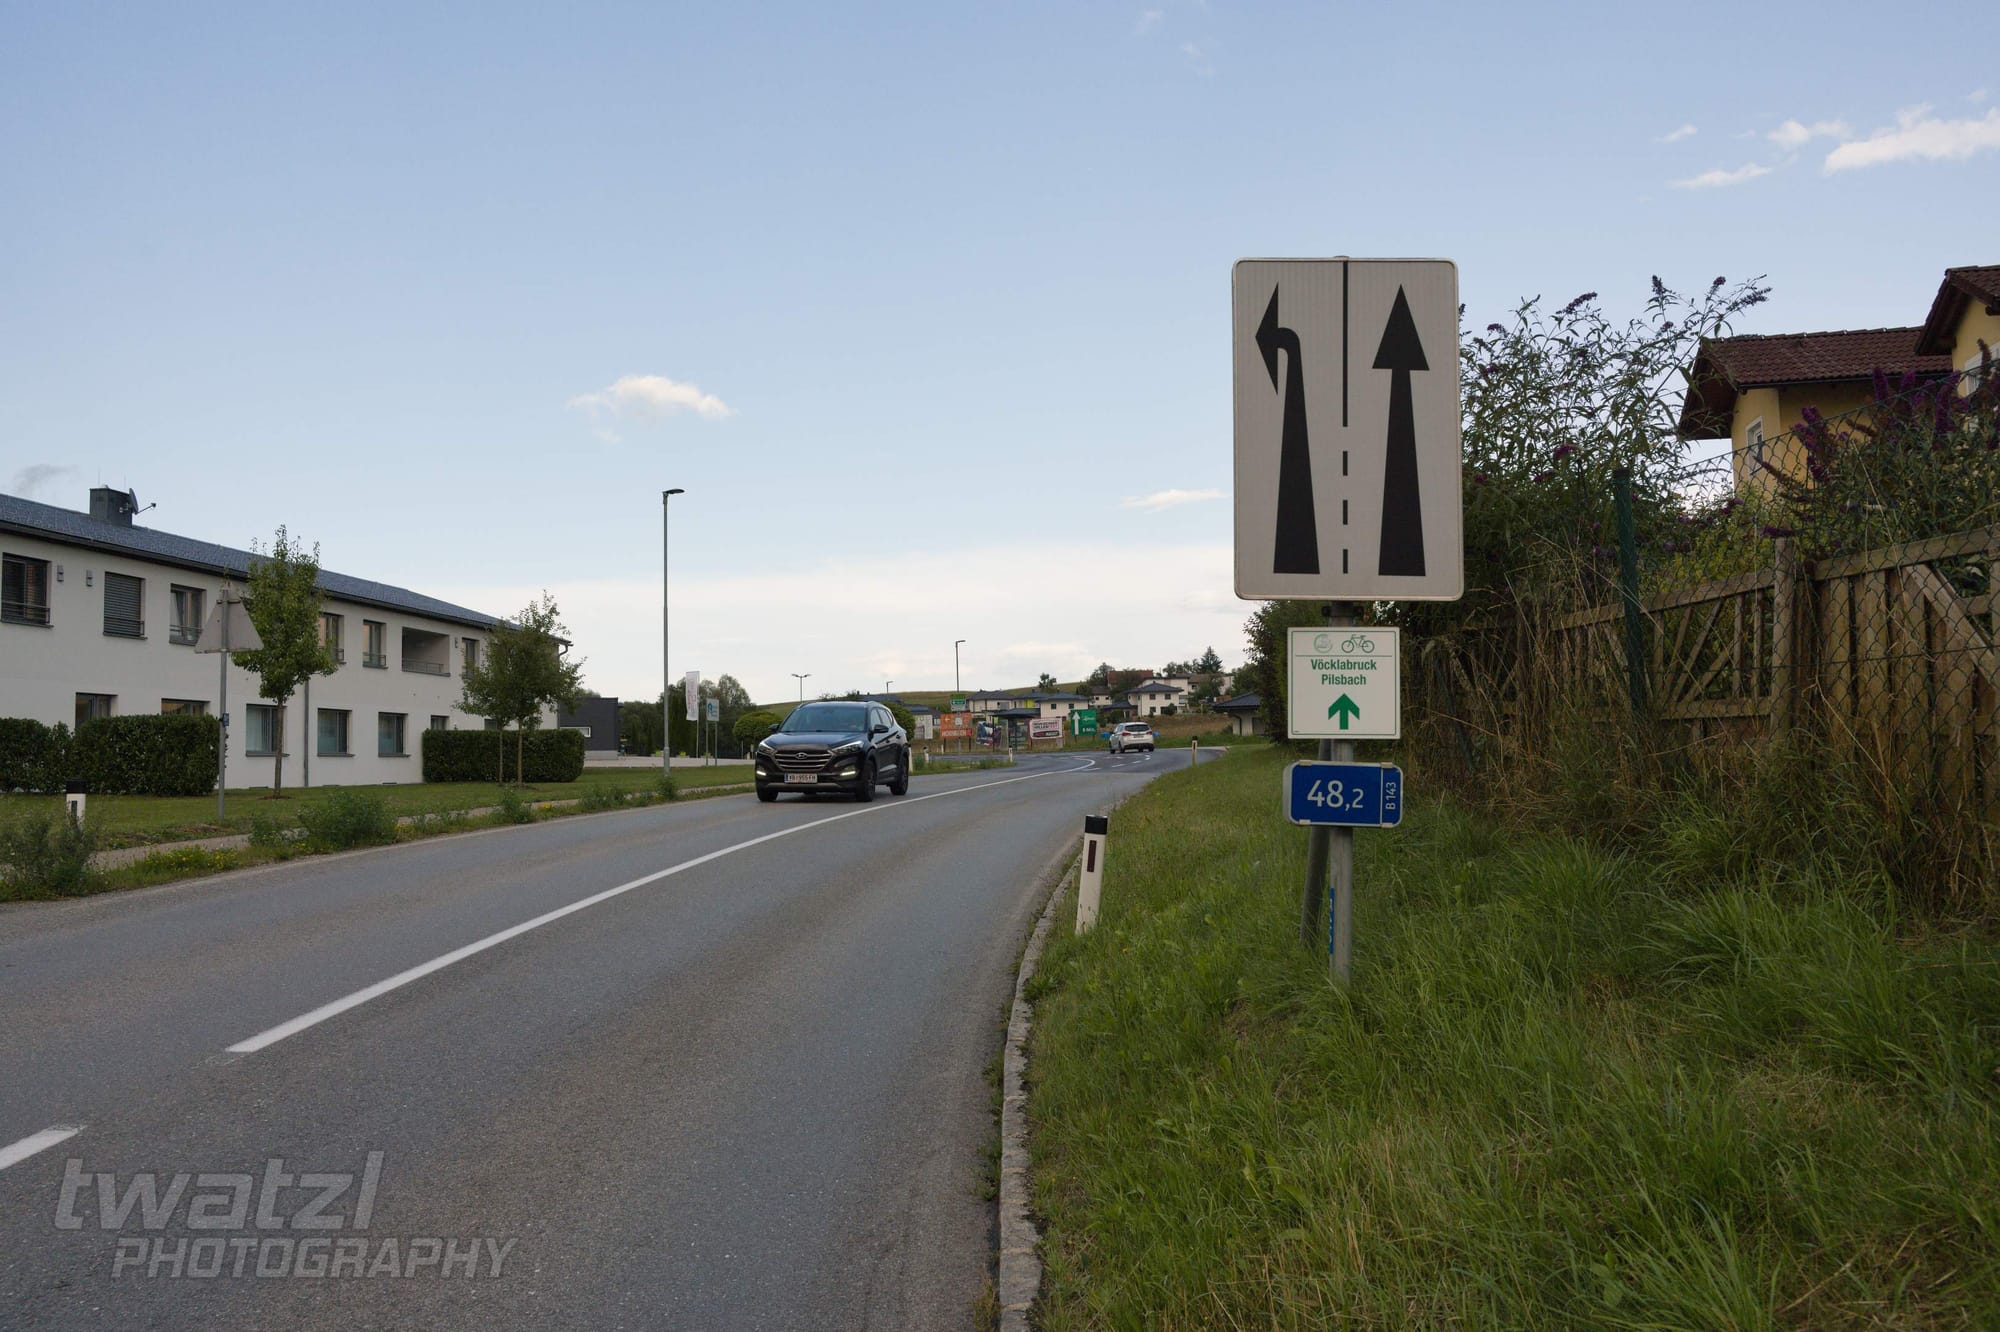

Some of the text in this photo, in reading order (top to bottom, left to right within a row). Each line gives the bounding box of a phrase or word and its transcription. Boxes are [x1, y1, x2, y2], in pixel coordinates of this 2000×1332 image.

[1311, 658, 1377, 670] Vöcklabruck
[1321, 674, 1367, 685] Pilsbach
[1307, 779, 1364, 811] 48,2
